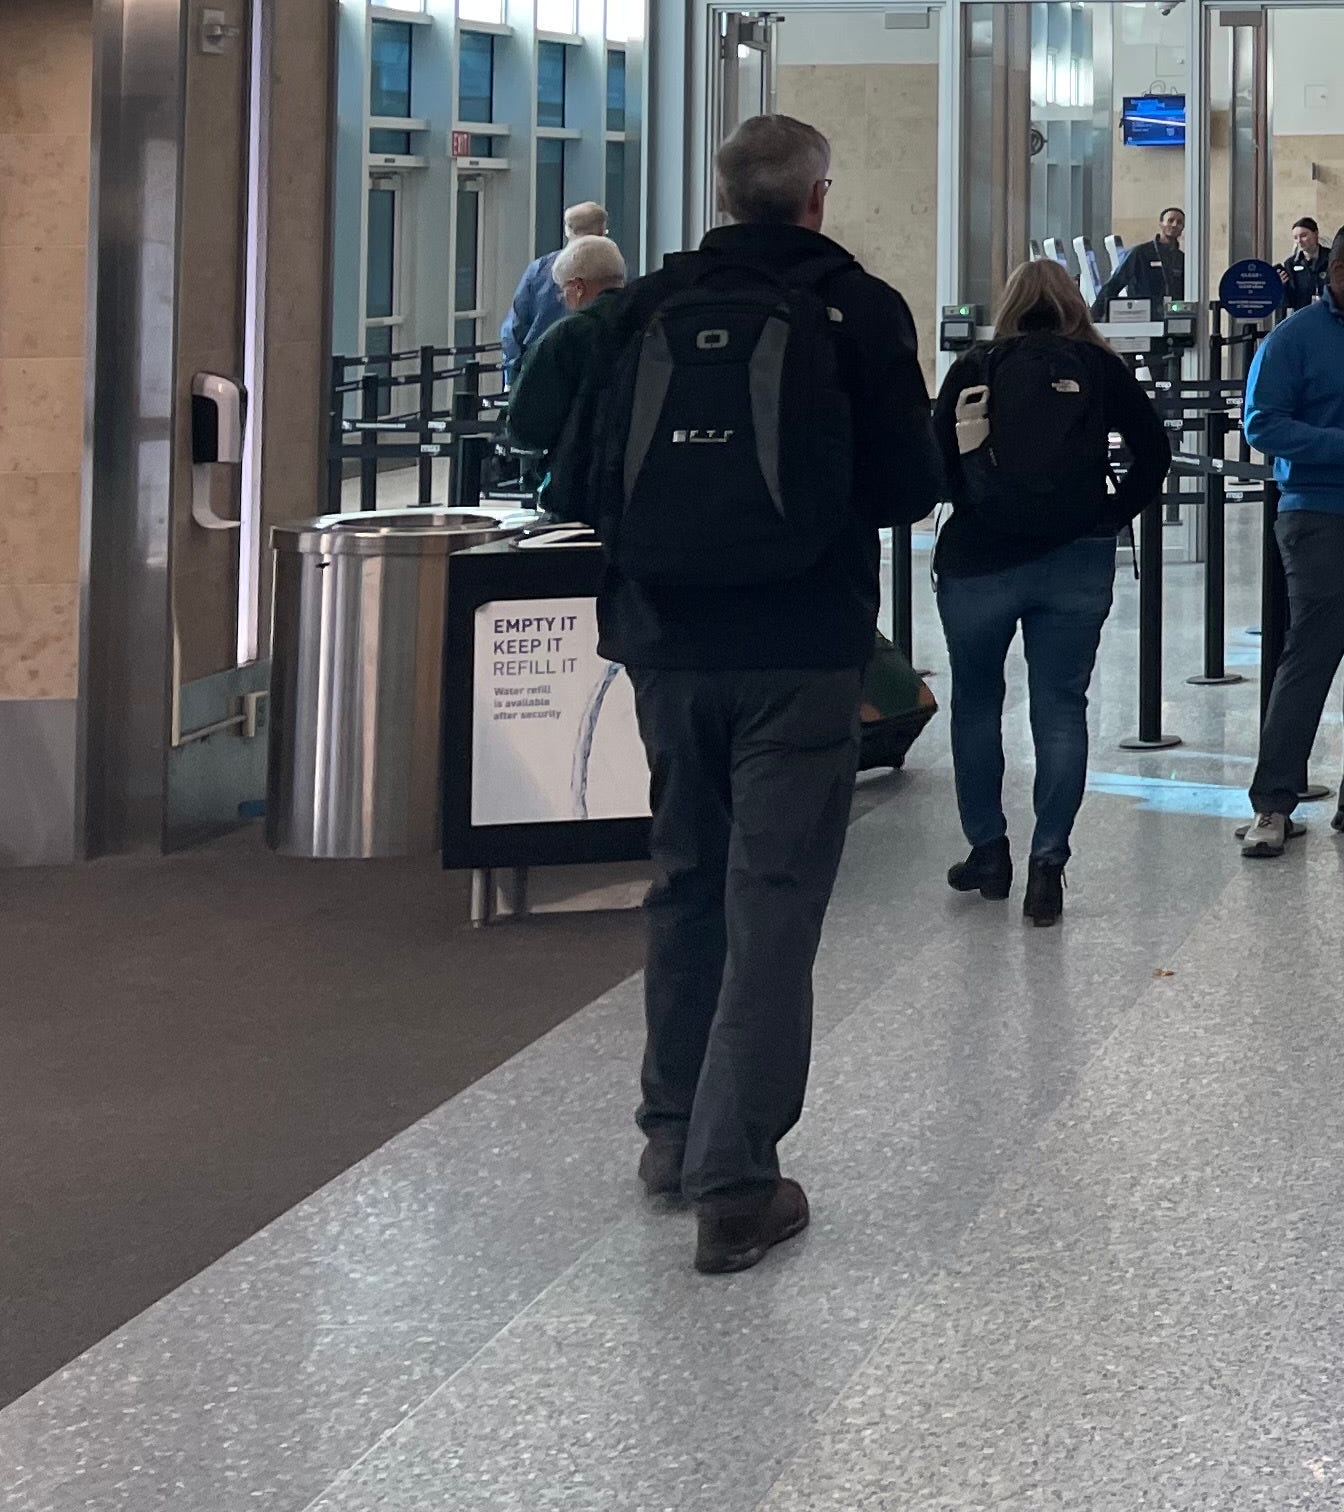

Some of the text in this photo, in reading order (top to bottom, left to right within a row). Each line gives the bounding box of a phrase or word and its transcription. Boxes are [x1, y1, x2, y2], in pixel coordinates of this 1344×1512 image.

[494, 616, 577, 634] EMPTY IT
[494, 638, 562, 655] KEEP IT
[494, 658, 578, 676] REFILL IT
